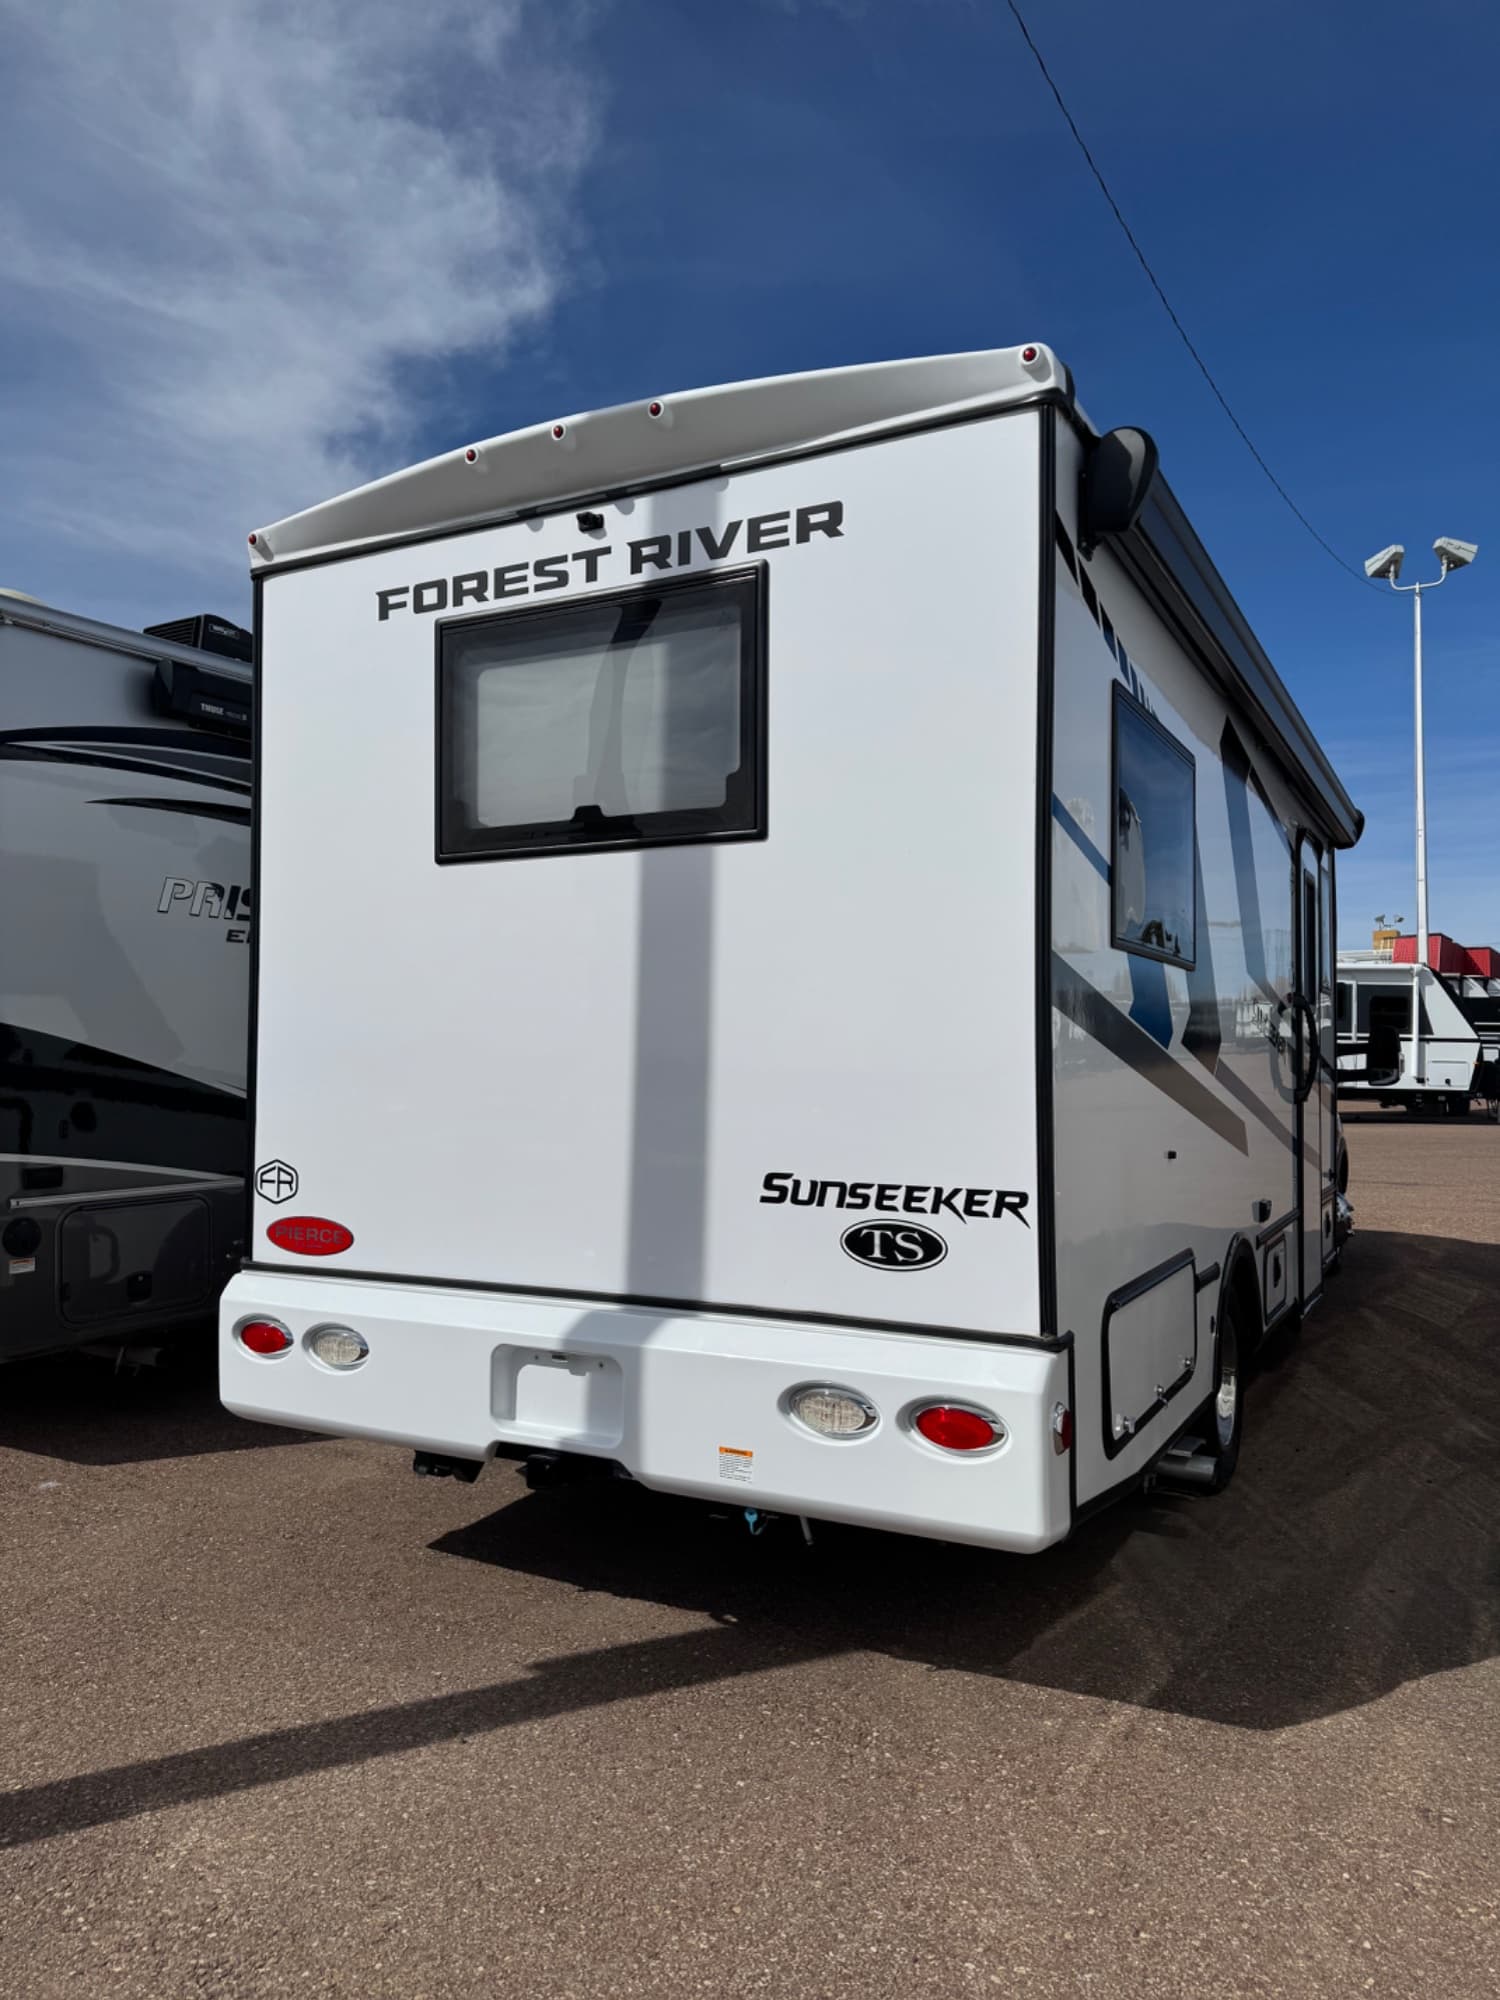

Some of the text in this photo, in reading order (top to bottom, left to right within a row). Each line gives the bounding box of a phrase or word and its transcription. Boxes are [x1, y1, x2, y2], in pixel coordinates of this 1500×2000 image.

[376, 501, 844, 621] FOREST RIVER
[759, 1172, 1031, 1229] SUNSEEKER
[274, 1225, 344, 1245] PIERCE
[860, 1229, 924, 1263] TS
